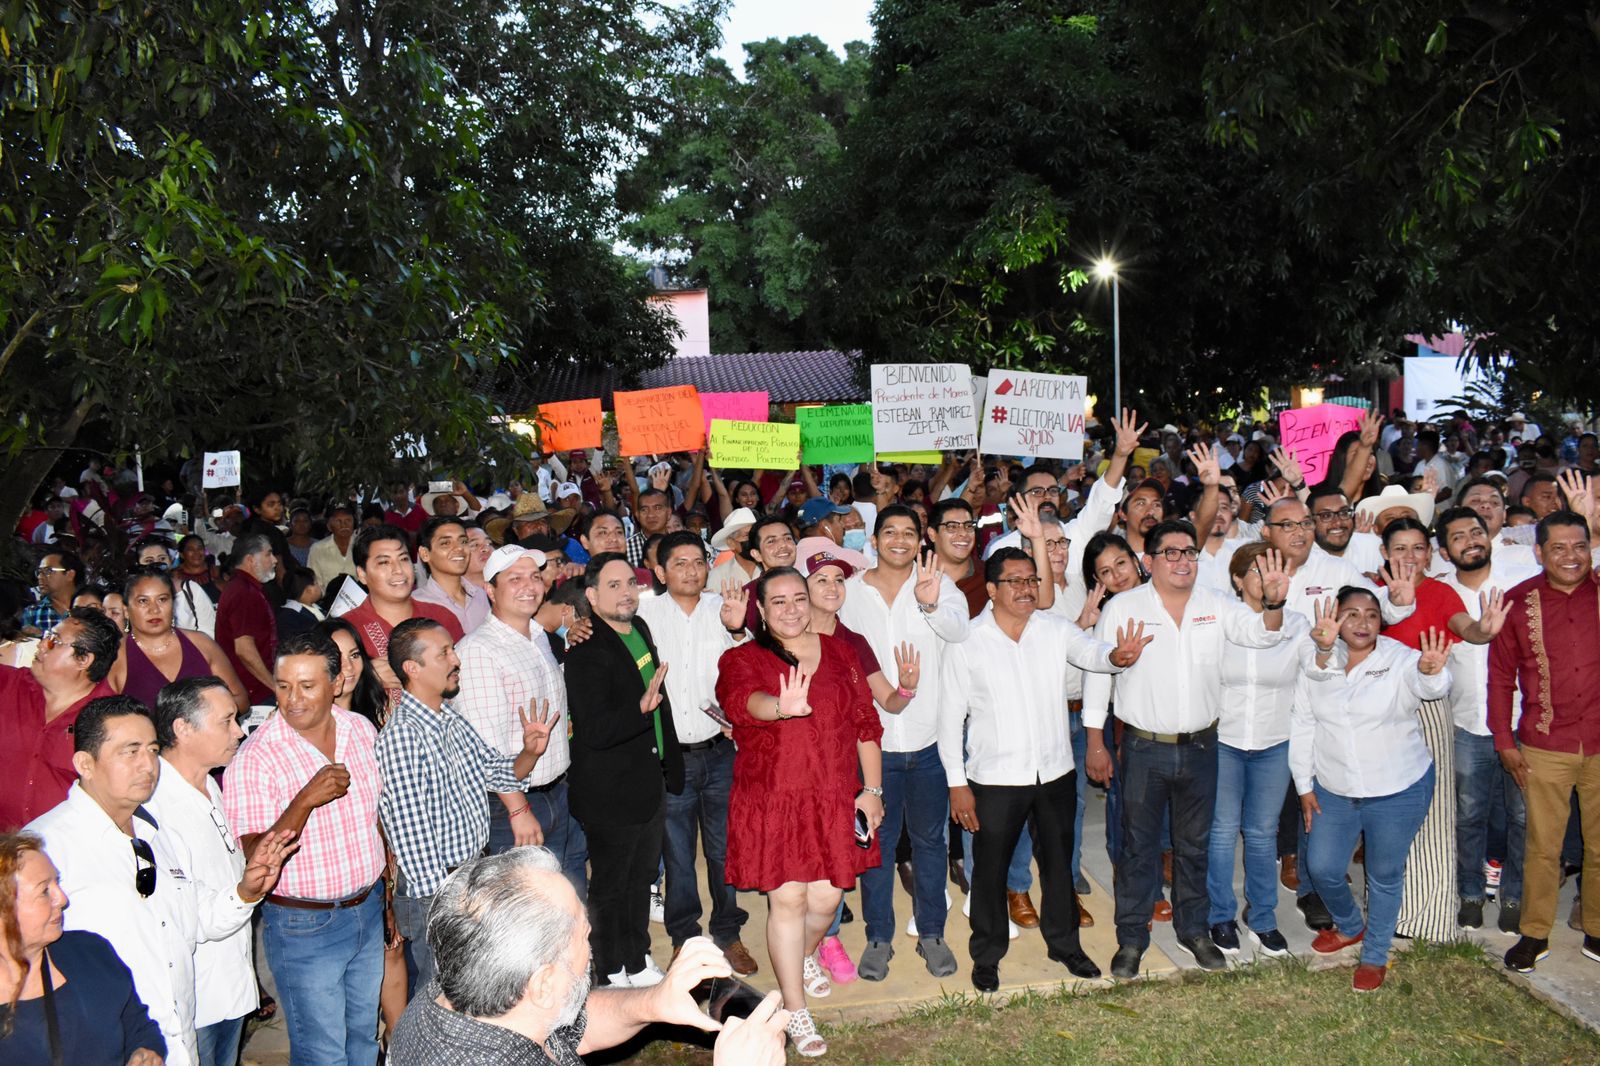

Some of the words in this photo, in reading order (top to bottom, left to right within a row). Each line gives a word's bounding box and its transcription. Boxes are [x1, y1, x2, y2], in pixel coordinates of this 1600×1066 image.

[883, 365, 957, 385] BIENVENIDO
[875, 387, 924, 404] Presidente
[928, 386, 940, 400] de
[1029, 378, 1081, 400] REFORMA
[638, 401, 676, 419] INE
[807, 406, 872, 418] ELIMINACION
[877, 407, 921, 423] ESTEBAN
[929, 406, 973, 420] RAMIREZ
[908, 420, 950, 435] ZEPETA
[641, 429, 690, 453] INEC
[1018, 428, 1054, 445] SOMOS
[1365, 667, 1390, 676] morena
